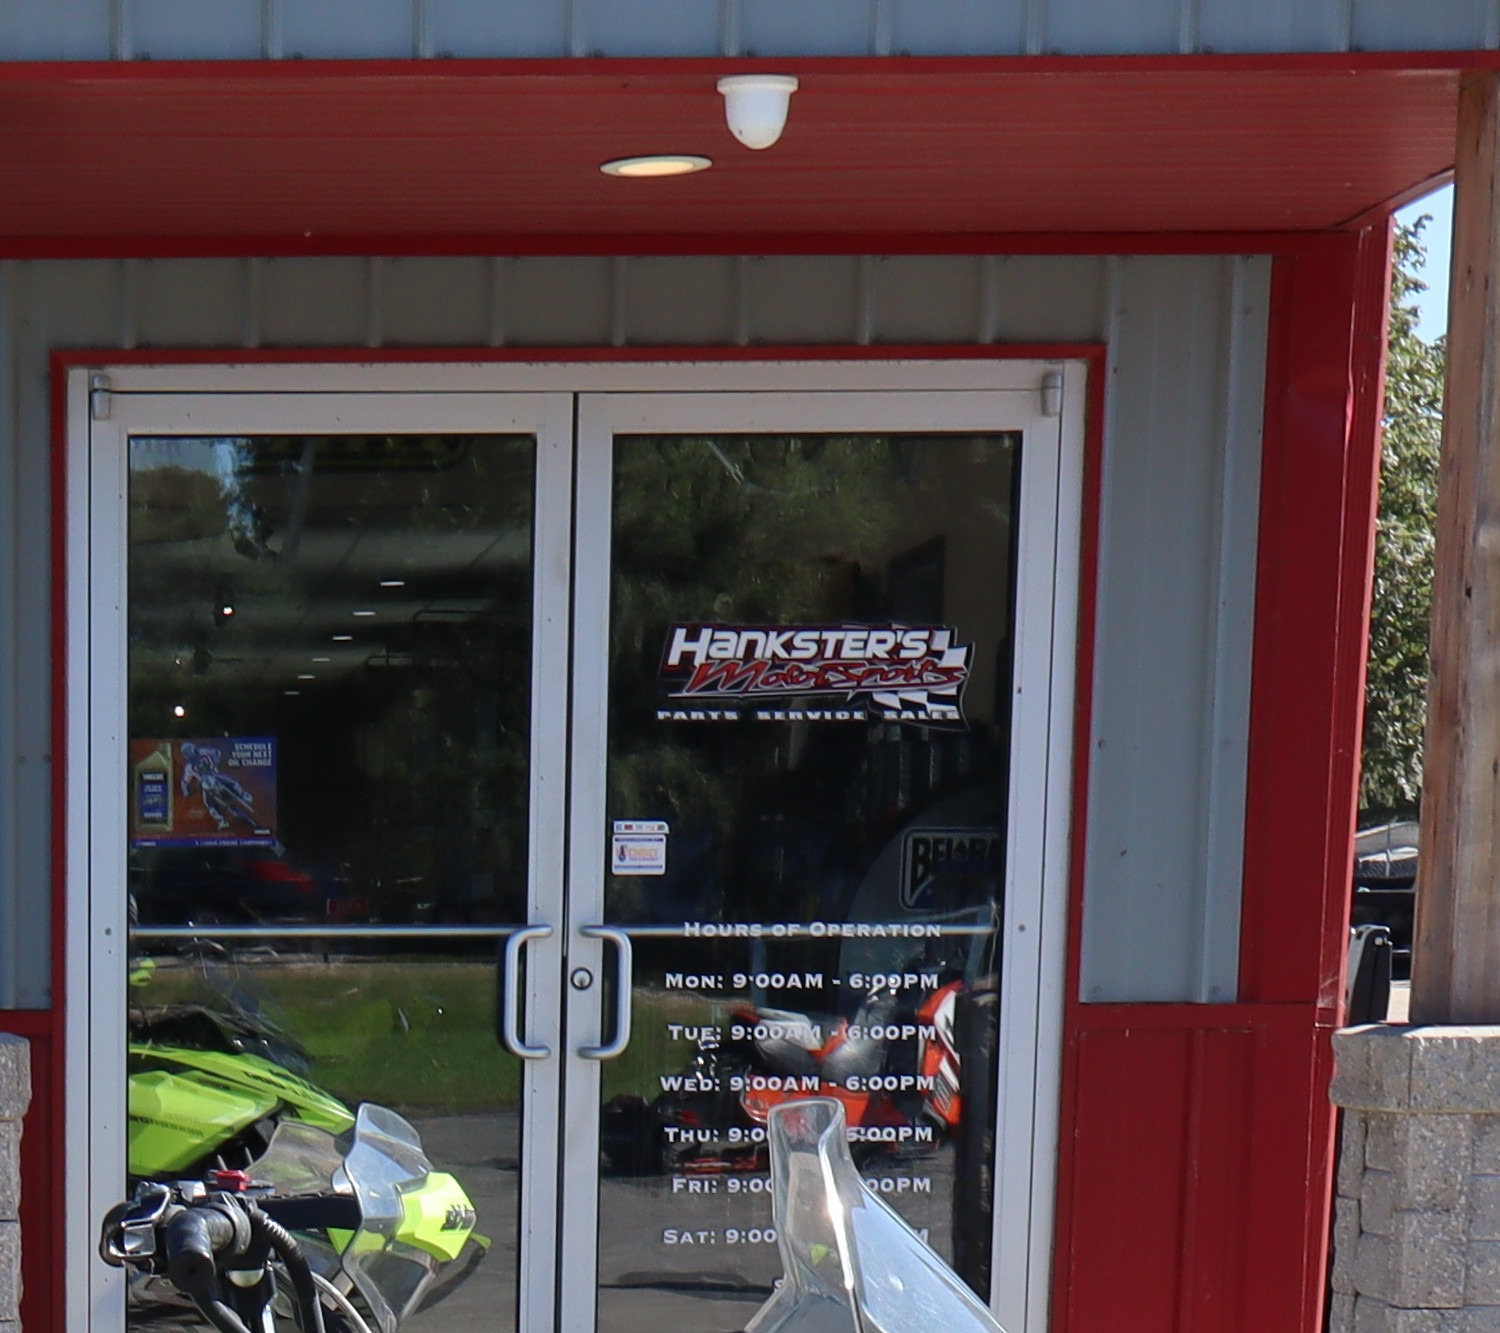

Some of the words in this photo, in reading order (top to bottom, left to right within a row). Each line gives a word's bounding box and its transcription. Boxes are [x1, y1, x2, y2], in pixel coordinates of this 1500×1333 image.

[657, 710, 739, 720] PARTS
[756, 710, 867, 720] SERVICE
[882, 710, 960, 720] SALES
[849, 973, 938, 989] 6:00PM
[731, 1025, 821, 1040] 9:00AM
[848, 1025, 936, 1040] 6:00PM
[730, 1076, 820, 1091] 9:00AM
[846, 1076, 935, 1091] 6:00PM
